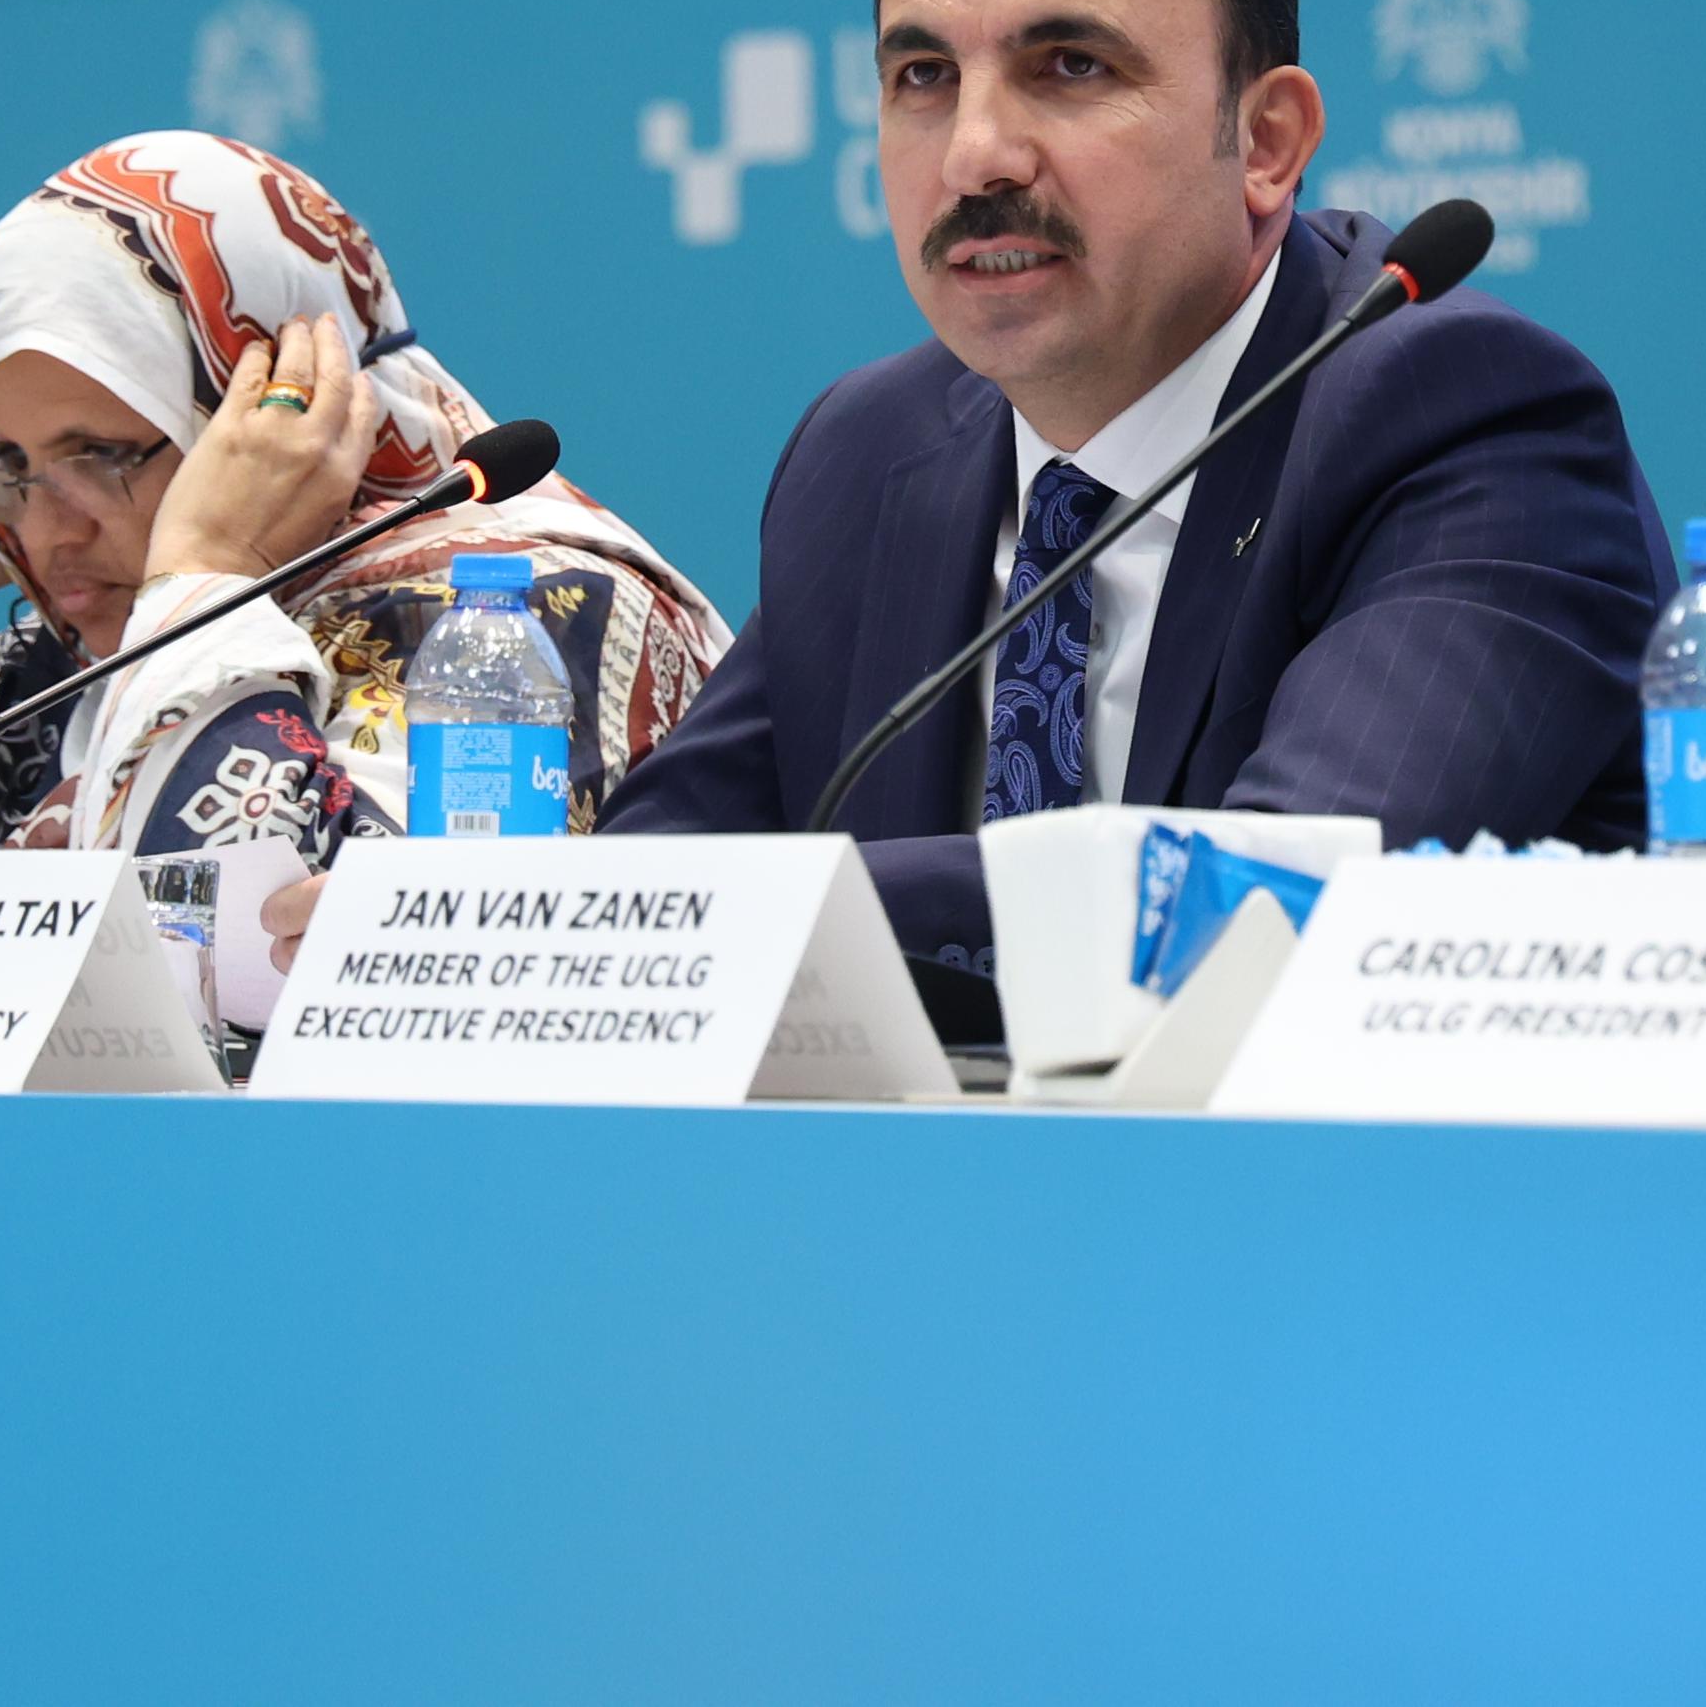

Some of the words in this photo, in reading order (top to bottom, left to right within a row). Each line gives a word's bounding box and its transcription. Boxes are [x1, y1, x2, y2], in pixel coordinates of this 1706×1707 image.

[531, 754, 569, 800] bey
[379, 890, 465, 929] JAN
[477, 890, 562, 929] VAN
[568, 891, 713, 930] ZANEN
[336, 952, 481, 986] MEMBER
[489, 953, 539, 987] OF
[548, 954, 614, 987] THE
[620, 955, 715, 988] UCLG
[1357, 938, 1606, 980] CAROLINA
[293, 1005, 487, 1040] EXECUTIVE
[488, 1008, 714, 1043] PRESIDENCY
[1361, 1001, 1472, 1034] UCLG
